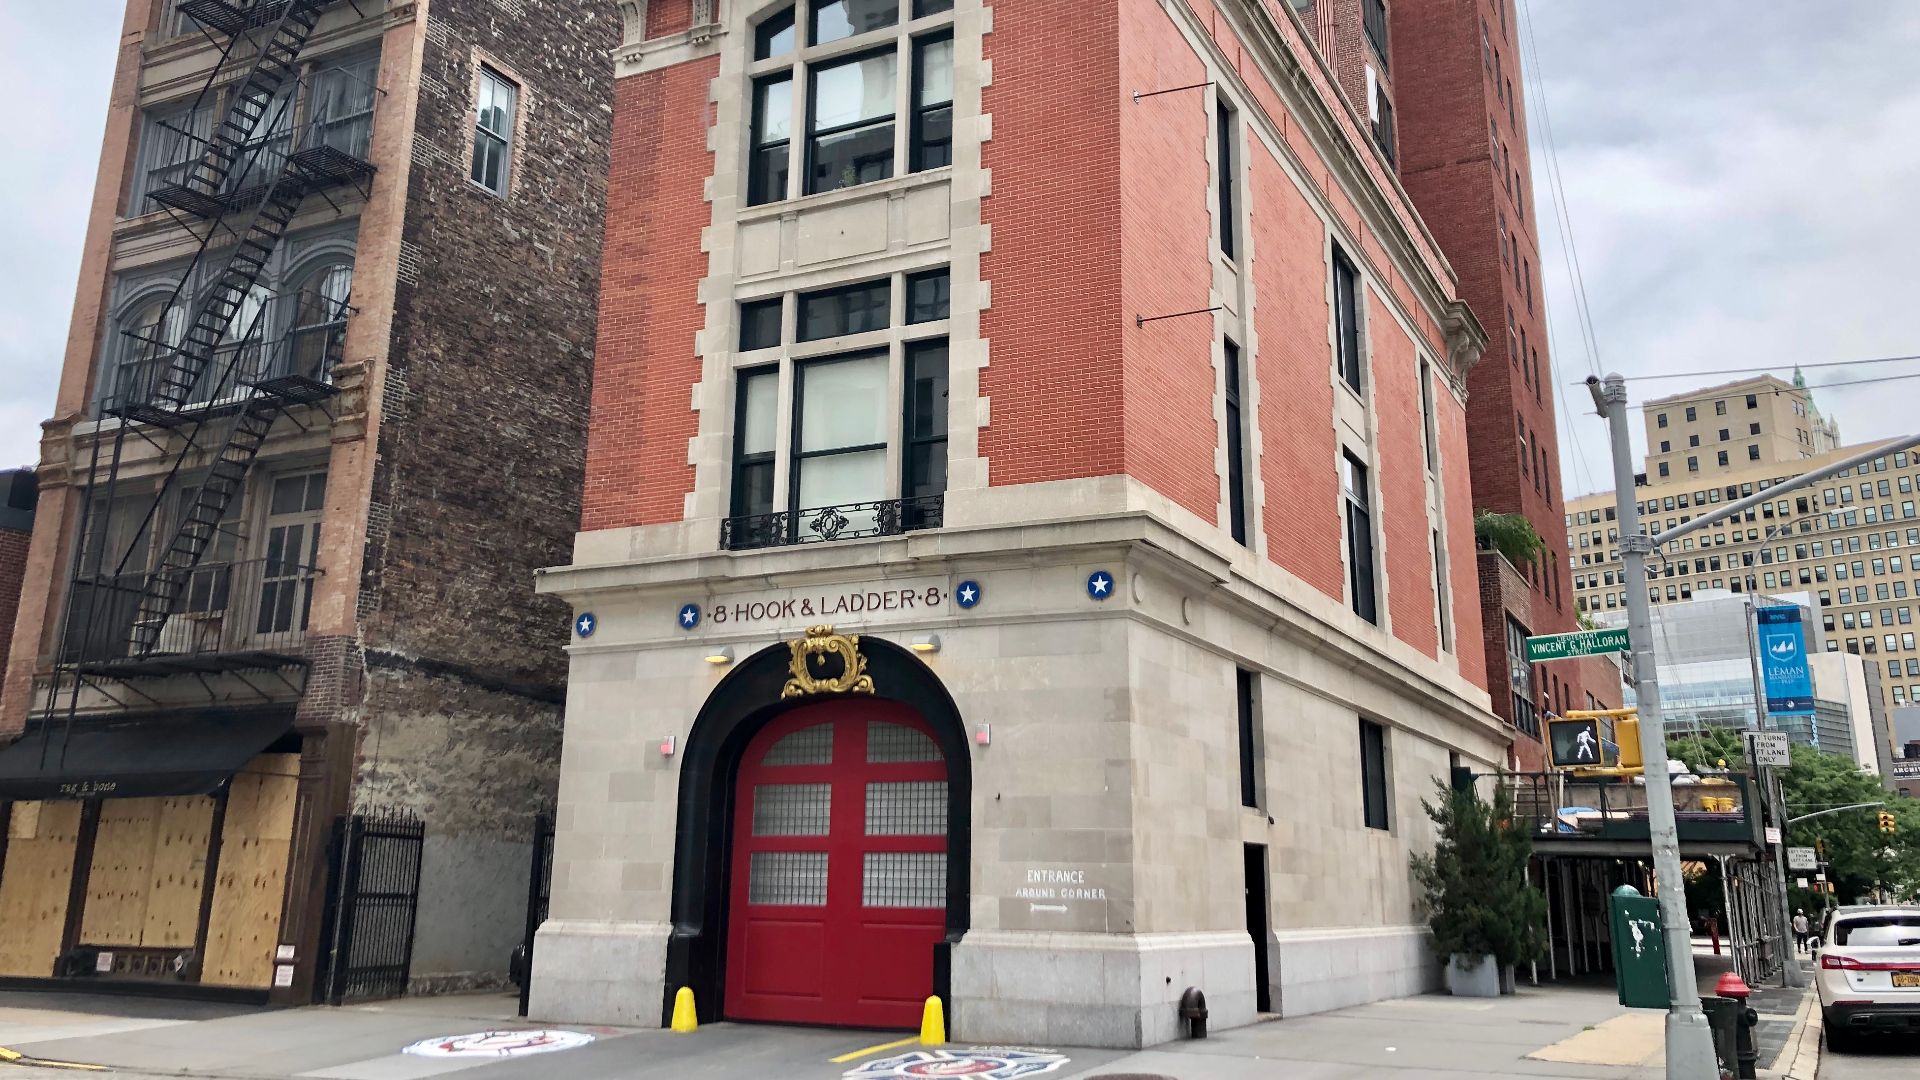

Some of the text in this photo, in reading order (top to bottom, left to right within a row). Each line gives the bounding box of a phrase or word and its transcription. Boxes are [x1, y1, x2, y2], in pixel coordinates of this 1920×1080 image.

[735, 599, 796, 622] HOOK
[800, 598, 816, 617] &
[820, 589, 915, 615] LADDER
[1556, 632, 1598, 642] LIEUTENANT
[1531, 635, 1627, 654] VINCENT G HALLORAN
[1566, 648, 1592, 656] STREET
[93, 781, 116, 791] bone
[1027, 869, 1085, 884] ENTRANCE
[1015, 888, 1105, 899] AROUND CORNER
